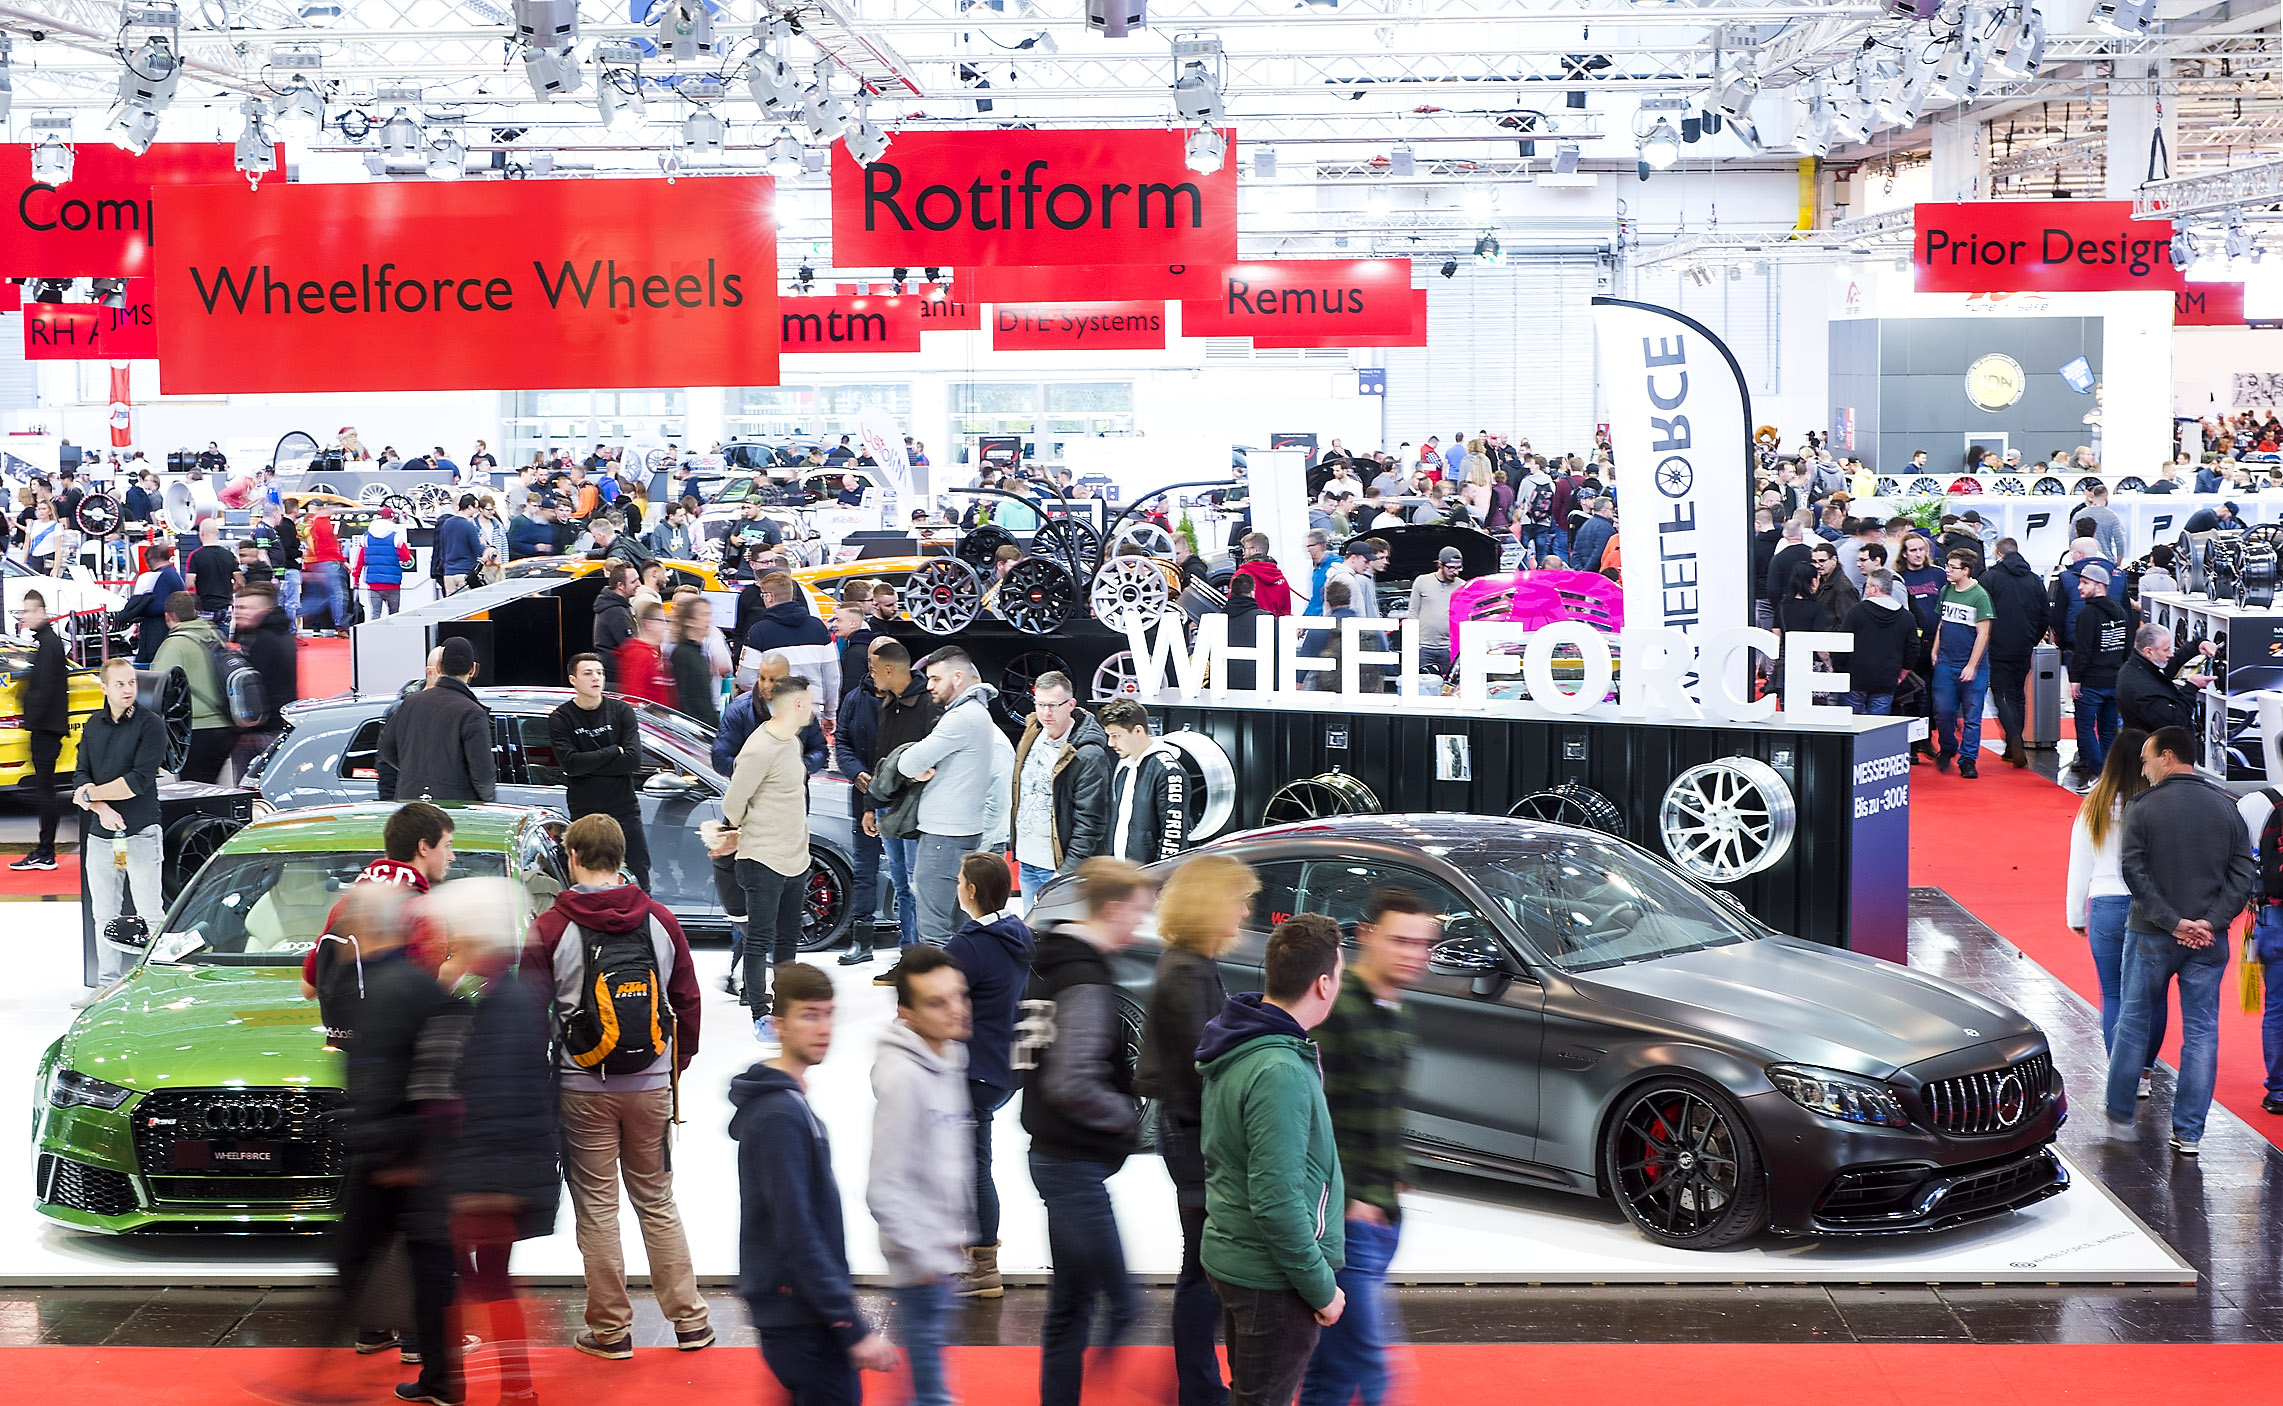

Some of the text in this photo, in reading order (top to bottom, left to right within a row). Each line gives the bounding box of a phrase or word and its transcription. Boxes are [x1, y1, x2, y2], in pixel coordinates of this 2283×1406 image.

[864, 160, 1203, 232] Rotiform
[1925, 227, 2172, 277] Prior Design
[189, 257, 744, 315] Wheelforce Wheels
[1227, 277, 1364, 316] Remus
[31, 318, 75, 345] RH
[782, 309, 887, 343] mtm
[998, 308, 1161, 339] DTE Systems
[1123, 611, 1855, 726] WHEELFORCE
[1852, 752, 1911, 787] MESSEPREIS
[1854, 795, 1868, 819] Bis
[1868, 798, 1880, 816] zu
[616, 981, 648, 994] KTM
[214, 1151, 271, 1161] WHEELFORCE
